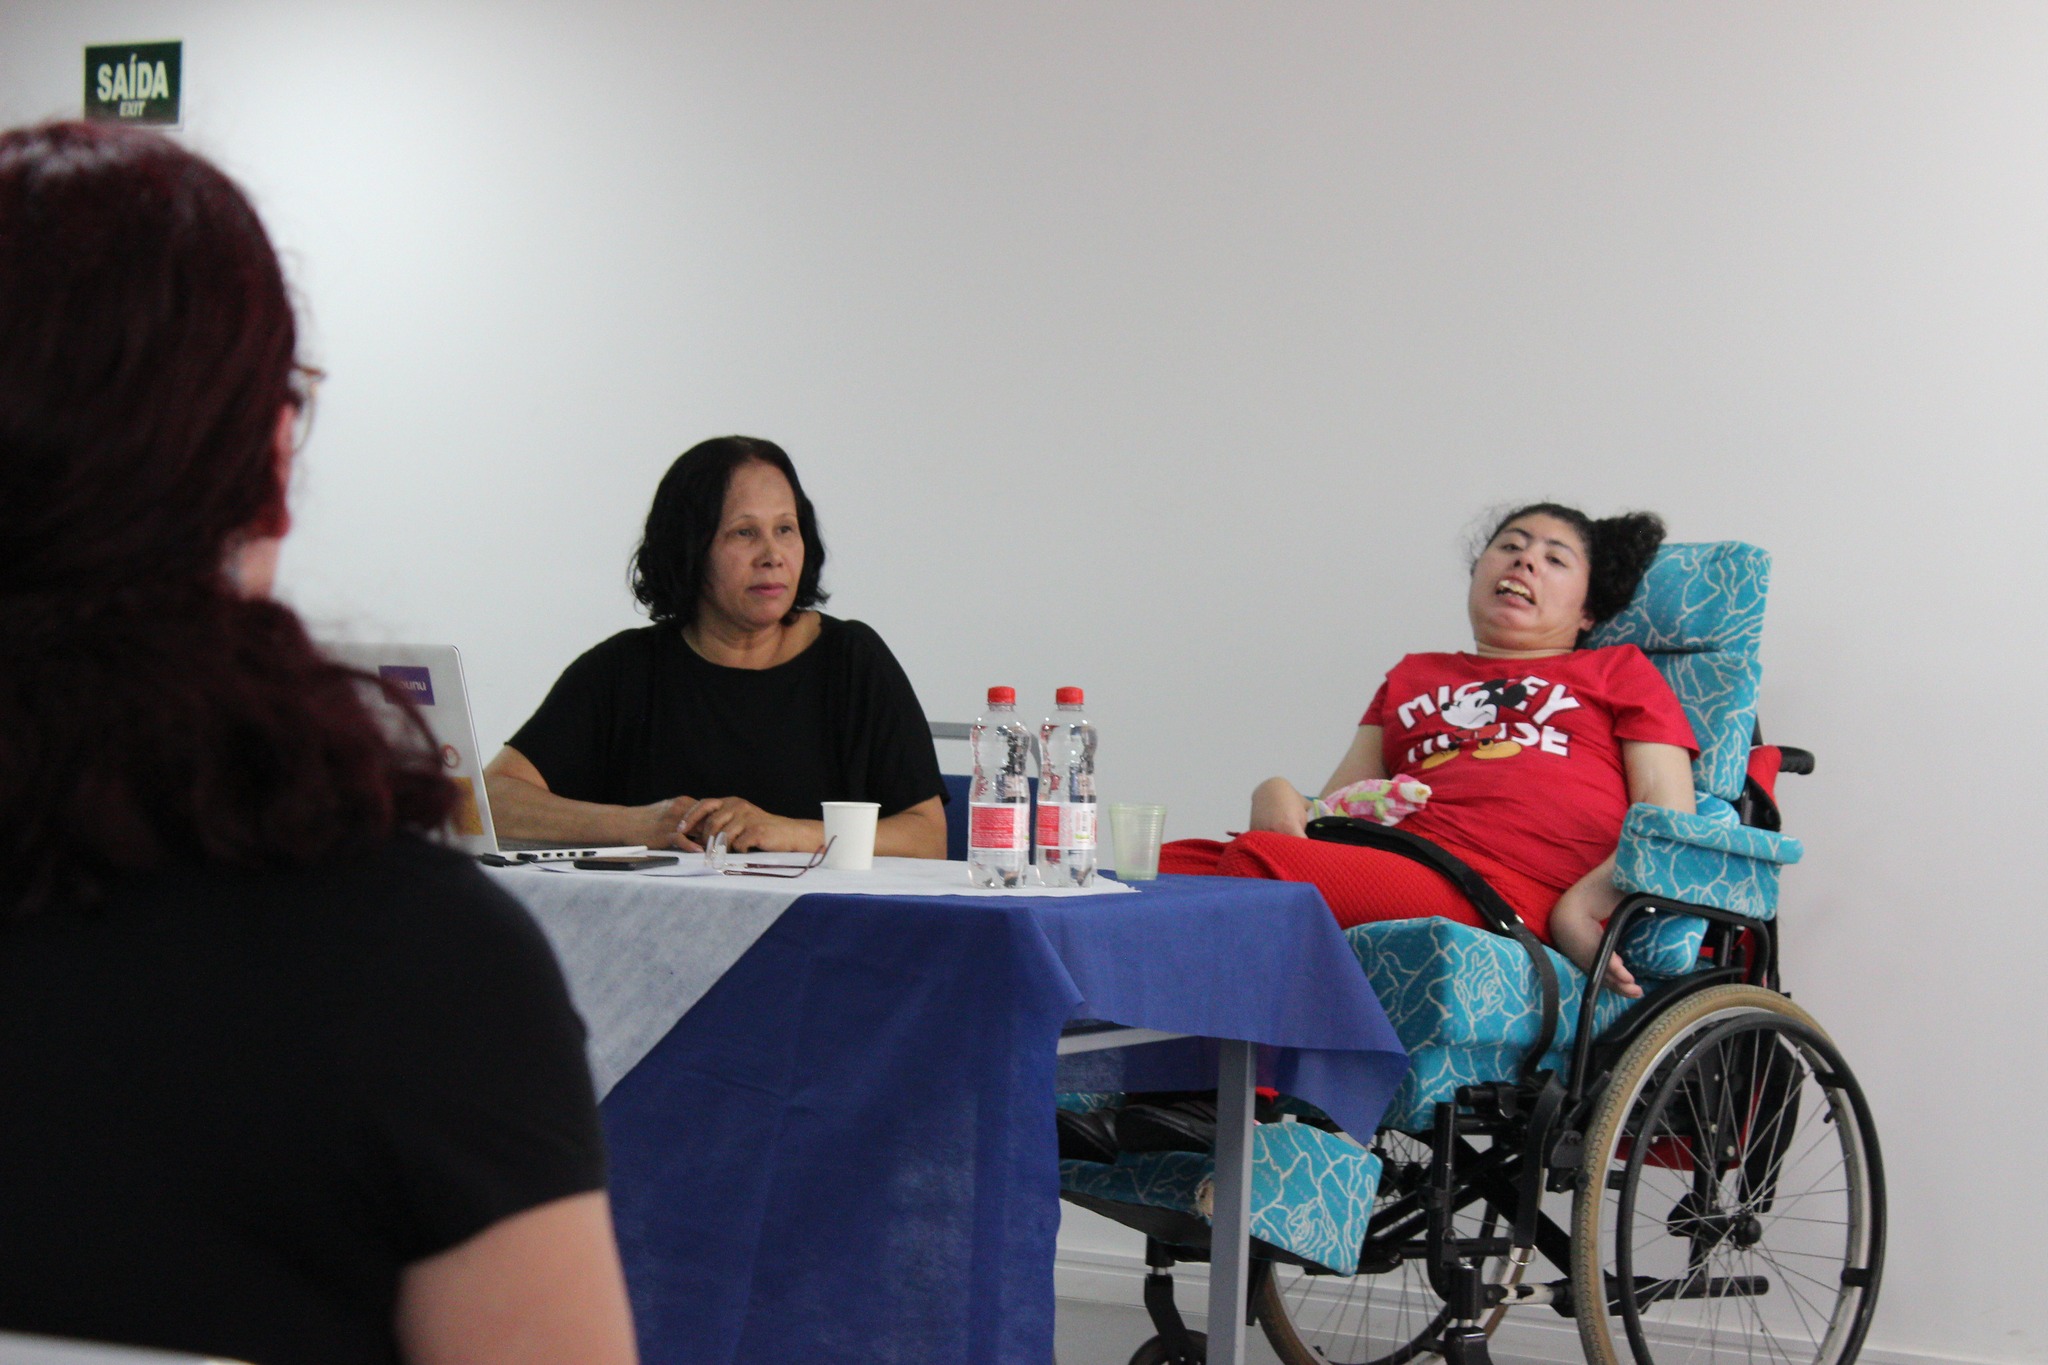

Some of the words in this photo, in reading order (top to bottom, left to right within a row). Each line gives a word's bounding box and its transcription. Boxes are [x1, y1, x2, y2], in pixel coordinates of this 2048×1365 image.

[97, 53, 169, 102] SAÍDA
[120, 101, 146, 117] EXIT
[1397, 675, 1582, 730] MICEY
